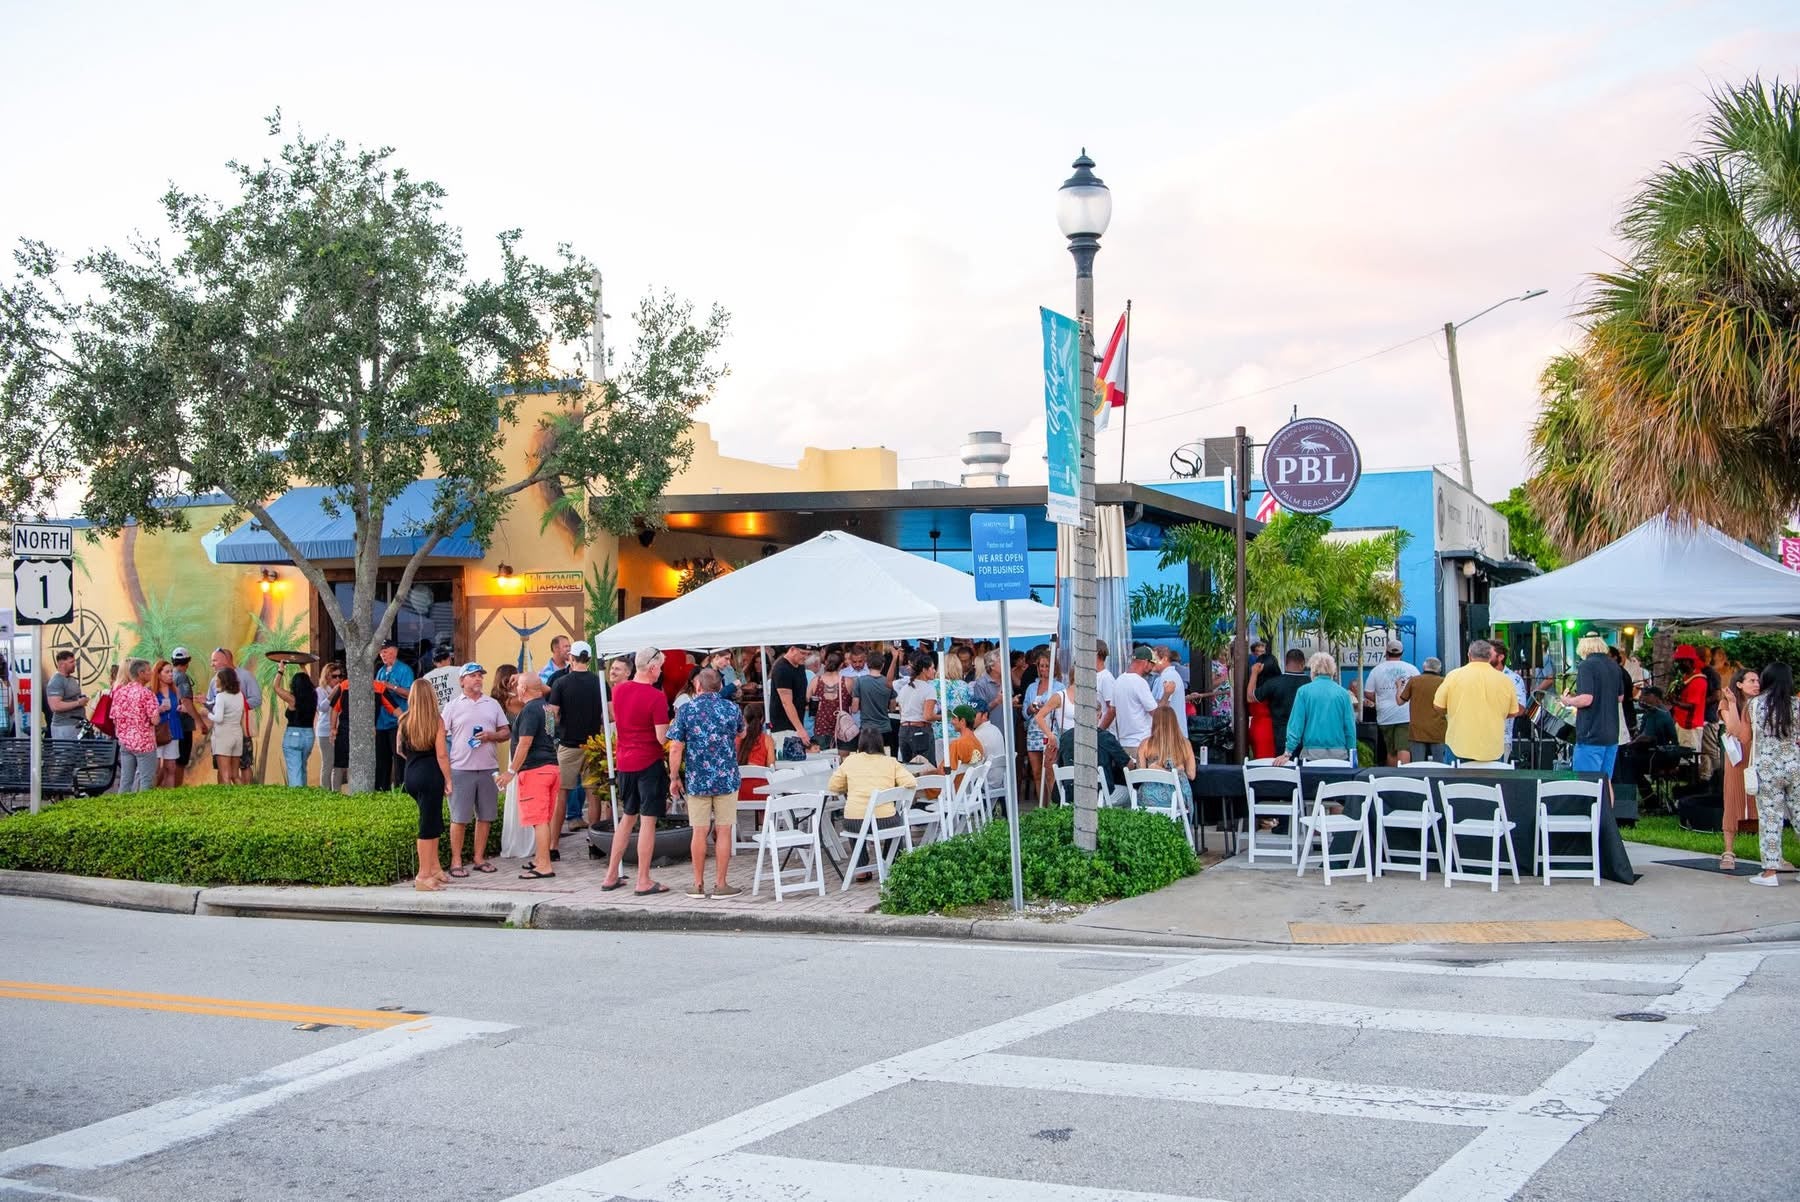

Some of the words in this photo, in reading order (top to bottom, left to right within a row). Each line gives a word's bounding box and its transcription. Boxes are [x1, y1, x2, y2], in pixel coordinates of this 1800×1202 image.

[1045, 315, 1060, 434] Welcome
[1276, 455, 1345, 484] PBL
[1281, 489, 1299, 505] PALM
[1303, 496, 1332, 507] BEACH,
[1331, 488, 1341, 497] FL
[17, 529, 69, 550] NORTH
[978, 554, 988, 562] WE
[990, 554, 1003, 562] ARE
[1005, 553, 1023, 562] OPEN
[979, 566, 992, 575] FOR
[993, 565, 1024, 574] BUSINESS
[40, 575, 48, 608] 1
